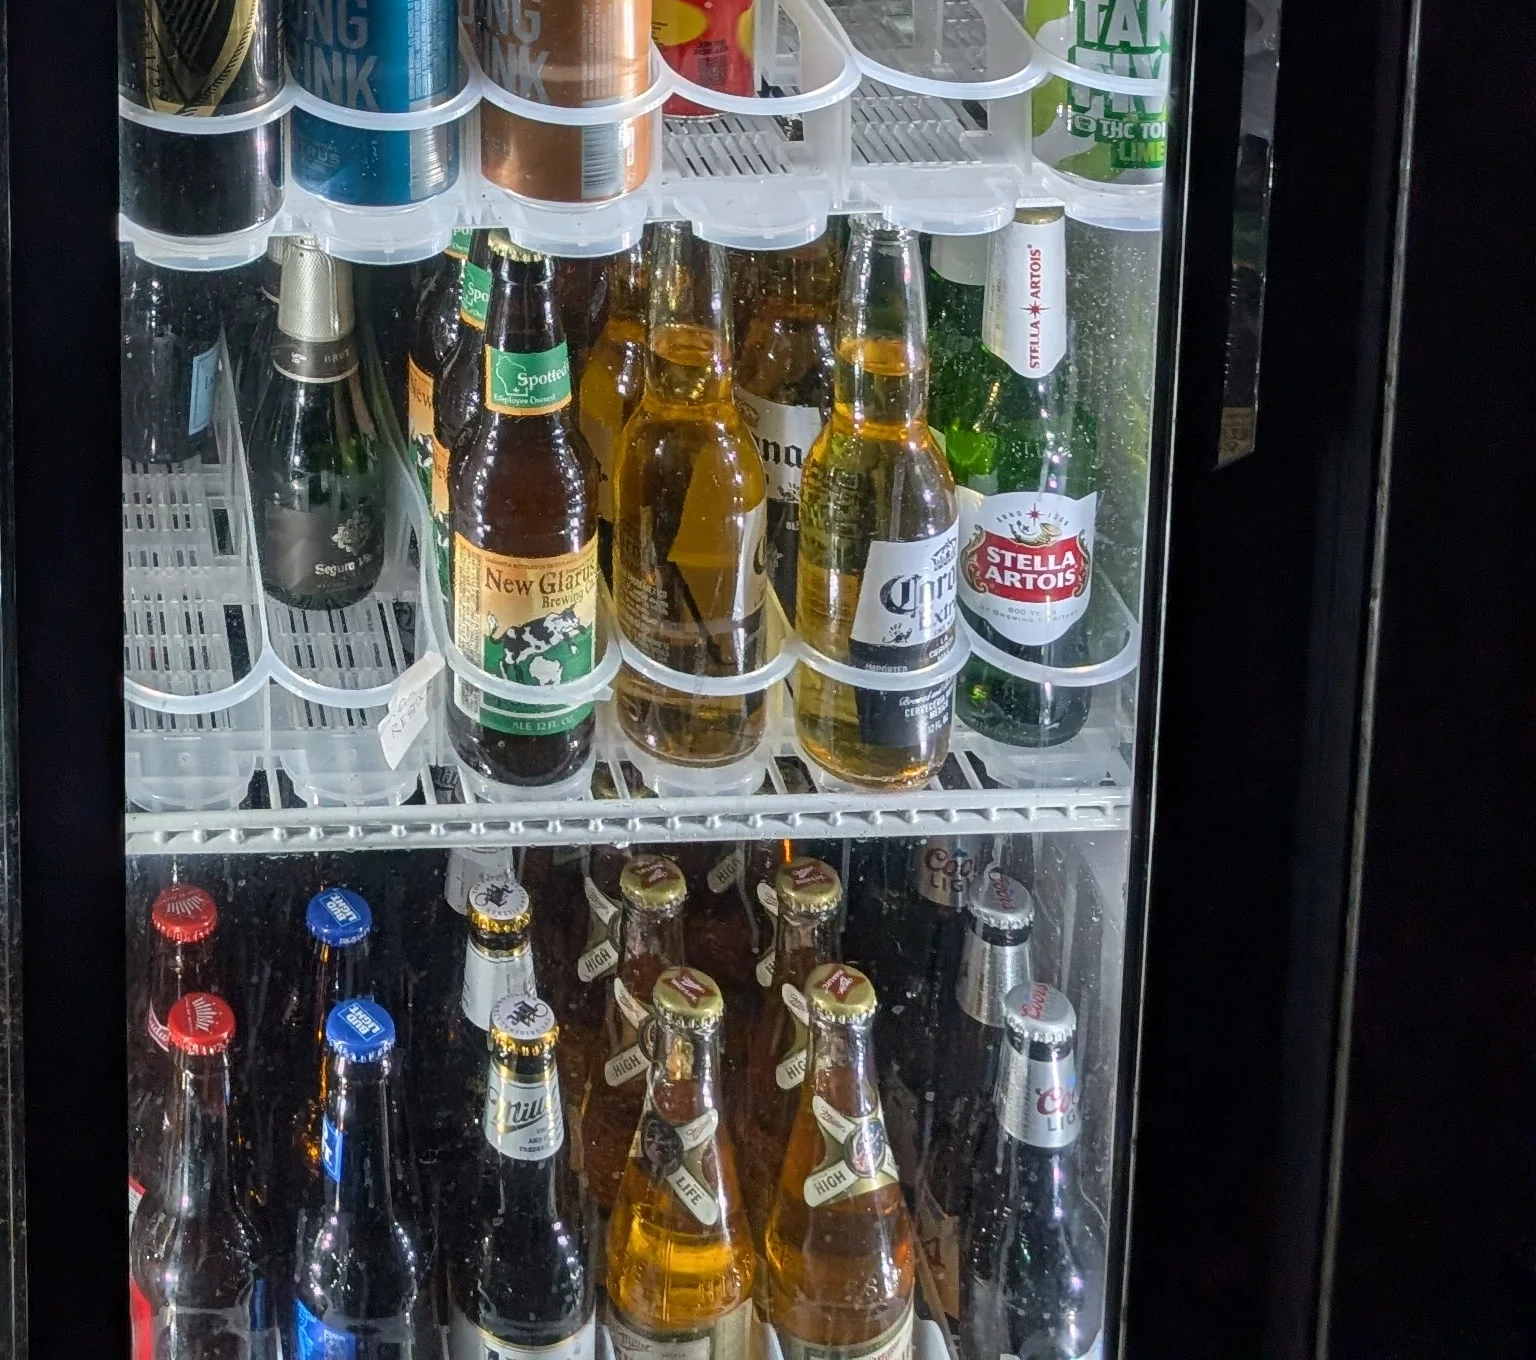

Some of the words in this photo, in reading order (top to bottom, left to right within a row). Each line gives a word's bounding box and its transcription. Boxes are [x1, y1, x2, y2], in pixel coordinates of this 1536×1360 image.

[1100, 120, 1134, 139] THC
[1030, 248, 1042, 300] ARTOIS
[1030, 320, 1041, 369] STELLA
[529, 394, 556, 405] Owned
[316, 562, 355, 577] Segura
[986, 545, 1076, 572] STELLA
[484, 567, 533, 596] New
[539, 563, 597, 595] Glarus
[985, 564, 1076, 590] ARTOIS
[542, 589, 585, 609] Brewing
[512, 722, 531, 730] ALE
[325, 901, 347, 923] BUD
[328, 892, 356, 921] LIGHT
[584, 949, 612, 972] HIGH
[1021, 983, 1049, 1020] Coors
[345, 1011, 368, 1035] BUD
[349, 1003, 381, 1033] LIGHT
[614, 1054, 641, 1077] HIGH
[676, 1176, 704, 1206] LIFE
[814, 1170, 846, 1195] HIGH
